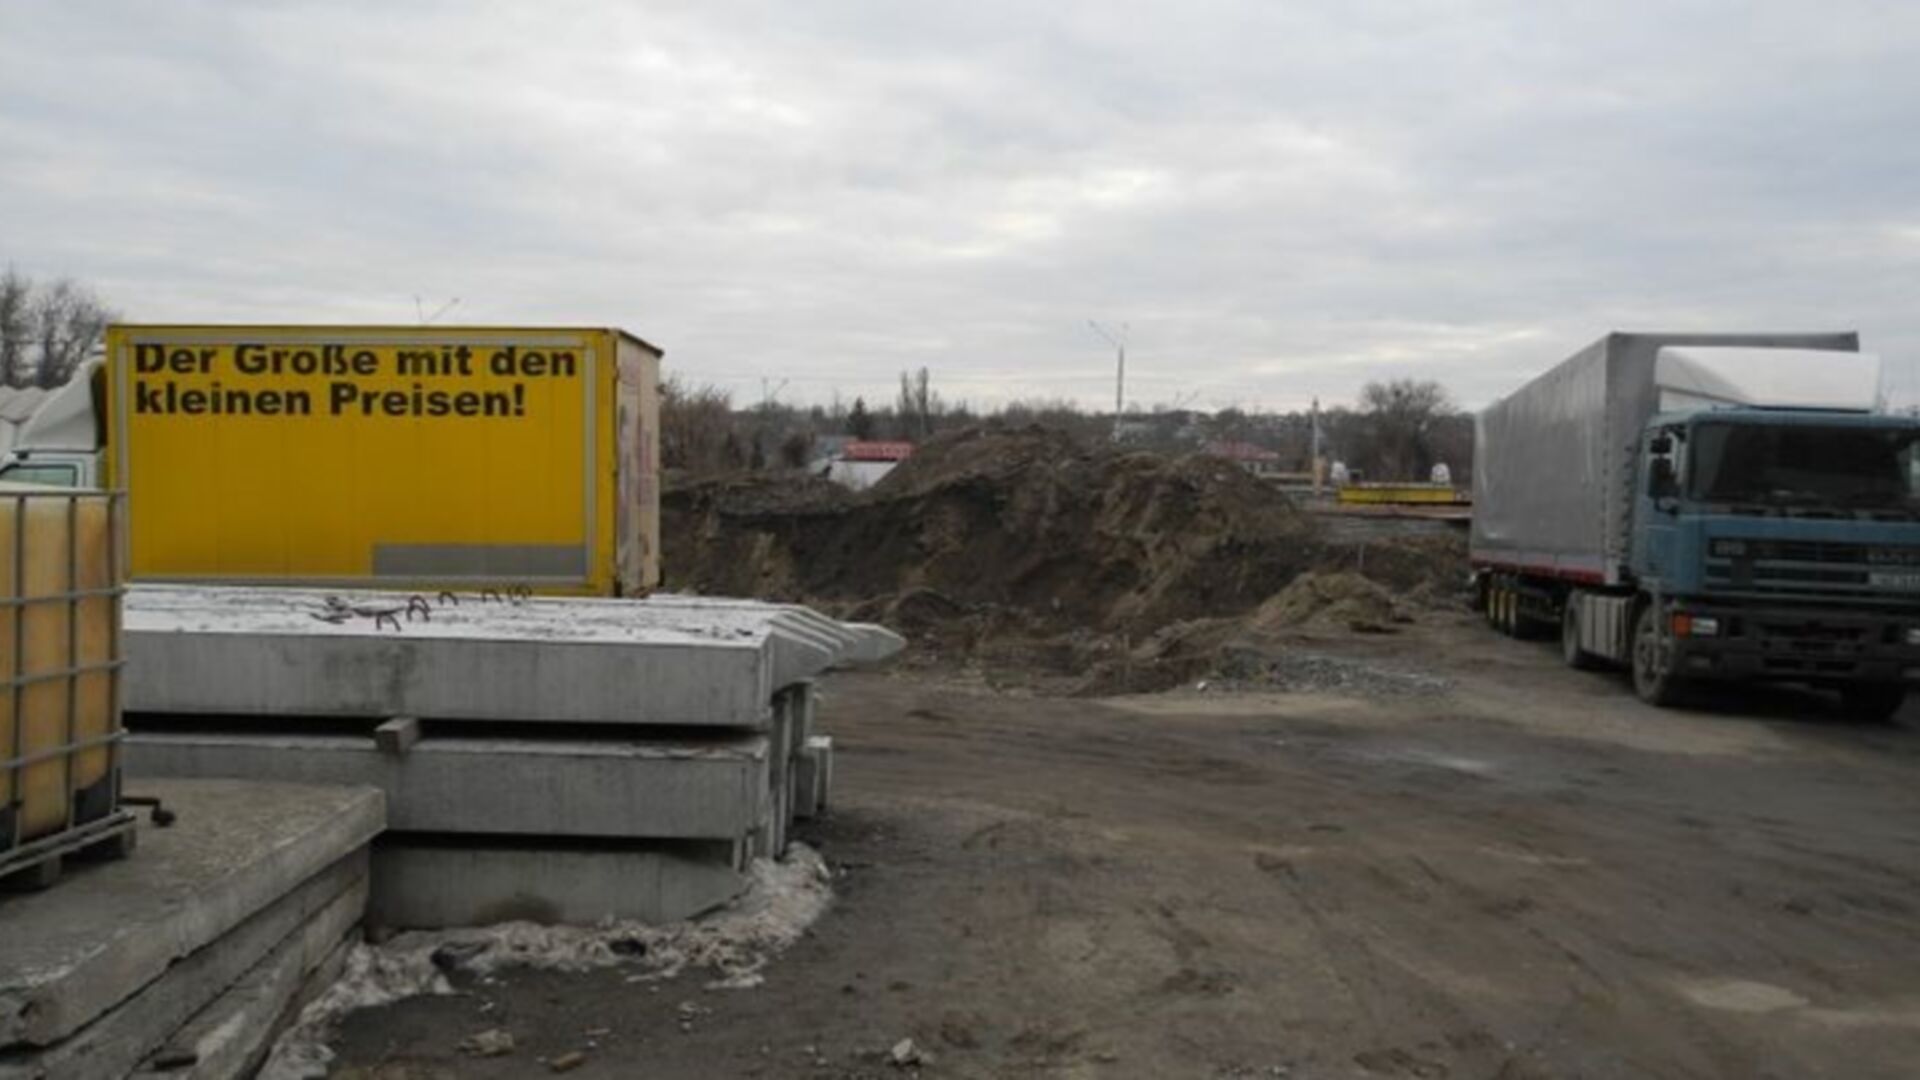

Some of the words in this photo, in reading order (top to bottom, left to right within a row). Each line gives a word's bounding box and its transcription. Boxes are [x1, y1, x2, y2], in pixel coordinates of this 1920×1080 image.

[135, 343, 217, 374] Der
[233, 343, 379, 375] Große
[396, 345, 473, 376] mit
[489, 345, 576, 376] den
[136, 381, 311, 415] kleinen
[330, 382, 525, 417] Preisen!
